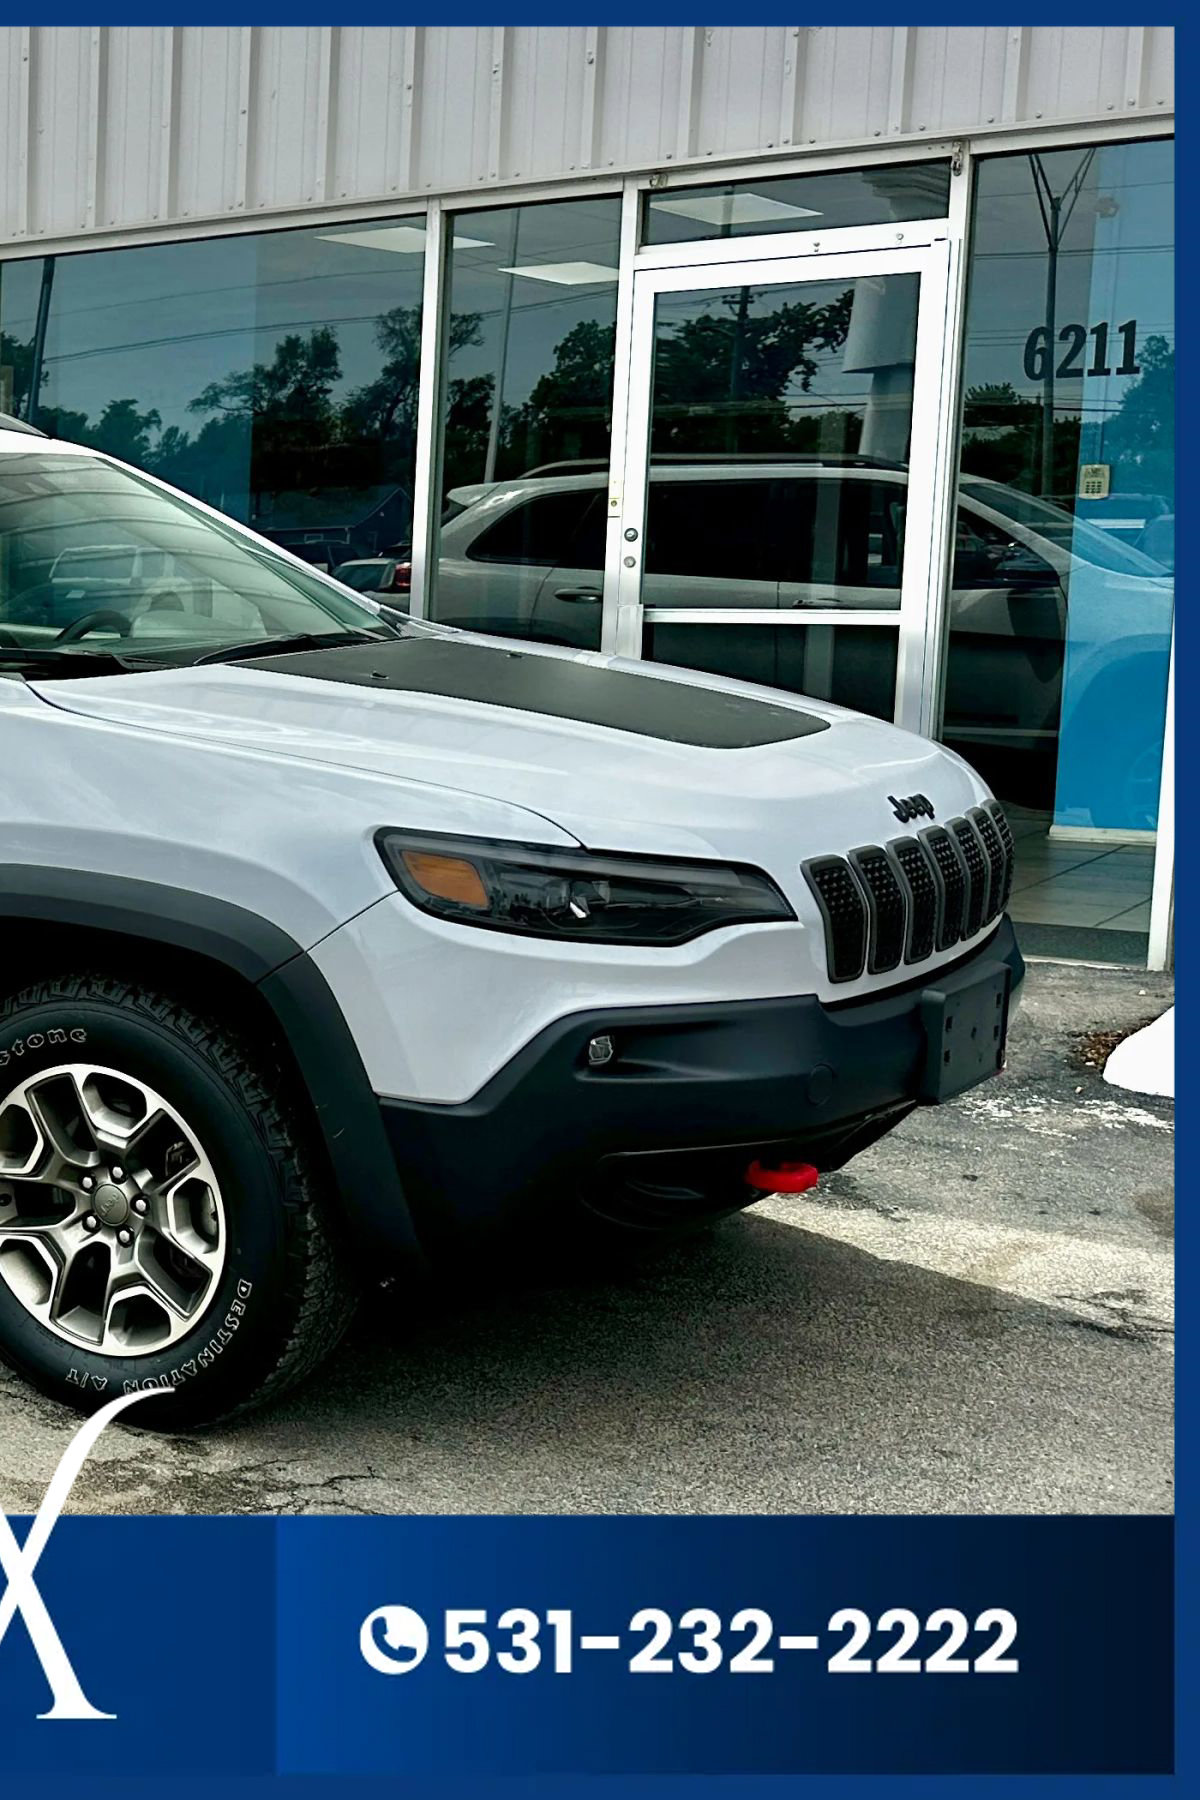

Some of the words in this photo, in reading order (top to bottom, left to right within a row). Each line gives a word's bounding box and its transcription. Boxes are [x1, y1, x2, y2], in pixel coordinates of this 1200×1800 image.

[1023, 319, 1141, 381] 6211
[887, 793, 935, 823] Jeep
[122, 1278, 252, 1394] DESTINATION
